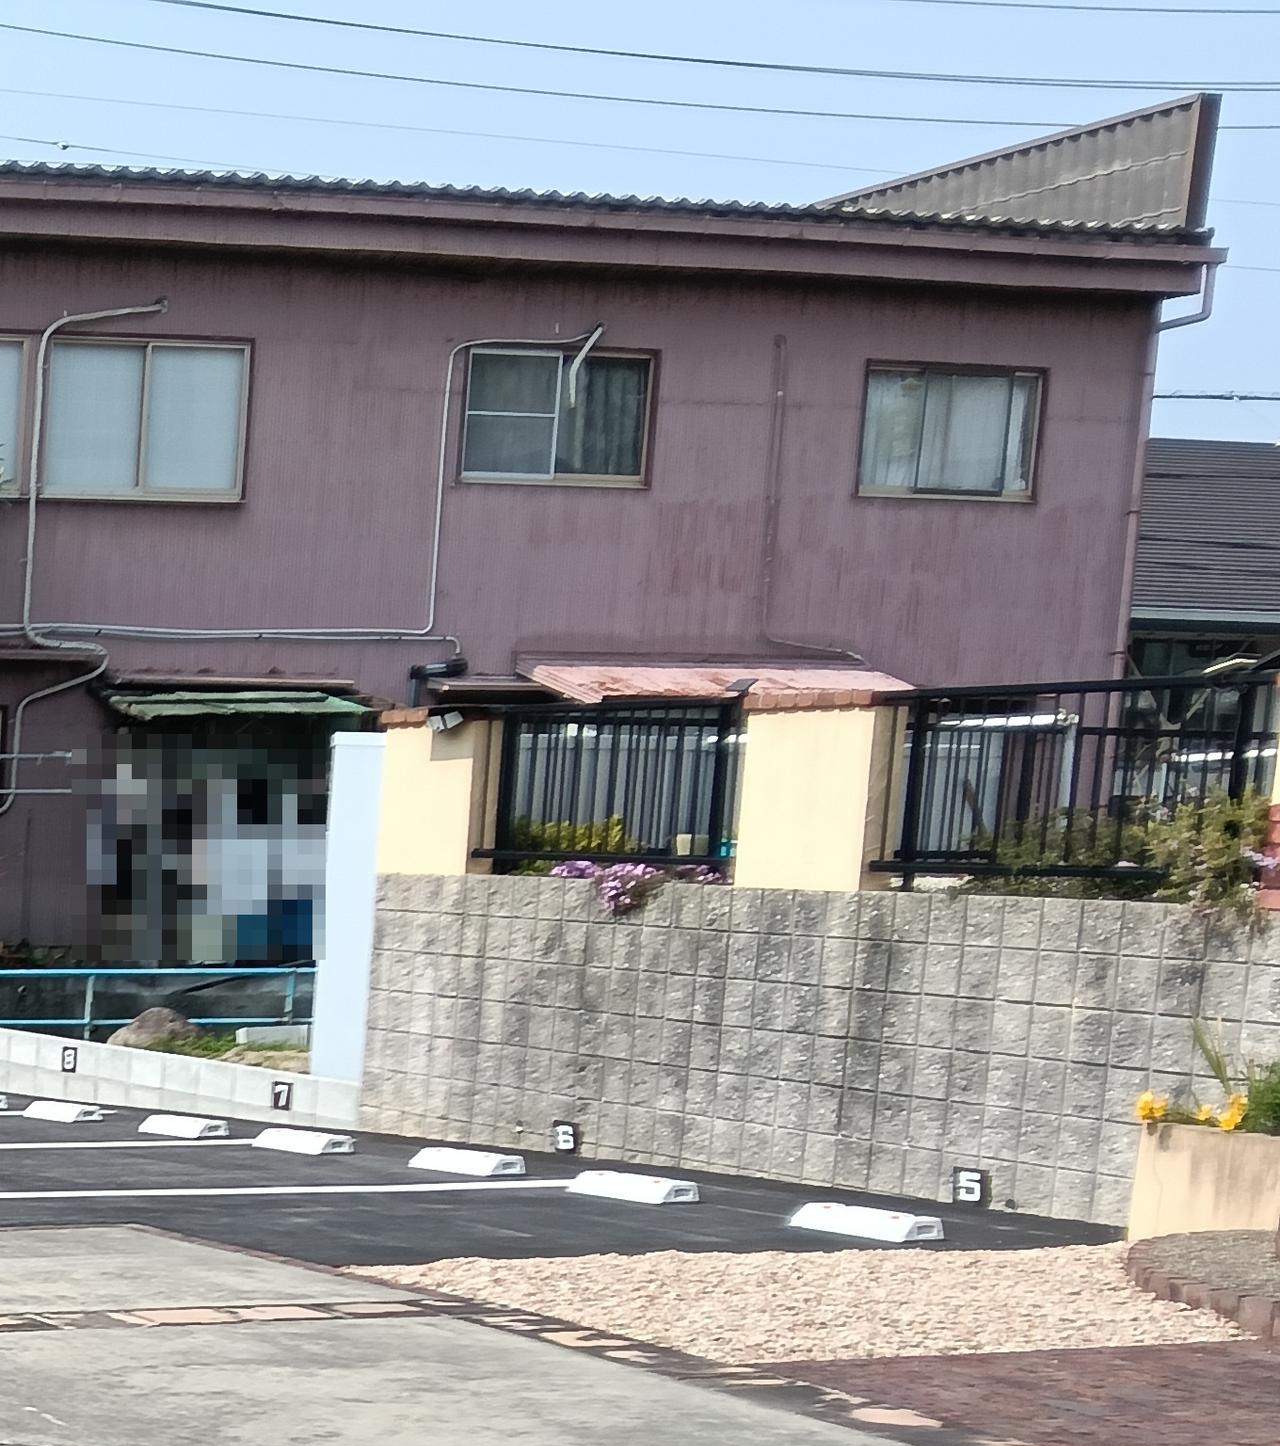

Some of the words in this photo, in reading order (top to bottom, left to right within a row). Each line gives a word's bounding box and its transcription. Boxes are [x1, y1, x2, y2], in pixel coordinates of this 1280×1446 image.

[64, 1049, 75, 1070] 8
[274, 1084, 289, 1107] 7
[556, 1125, 574, 1150] 6
[958, 1171, 981, 1202] 5
